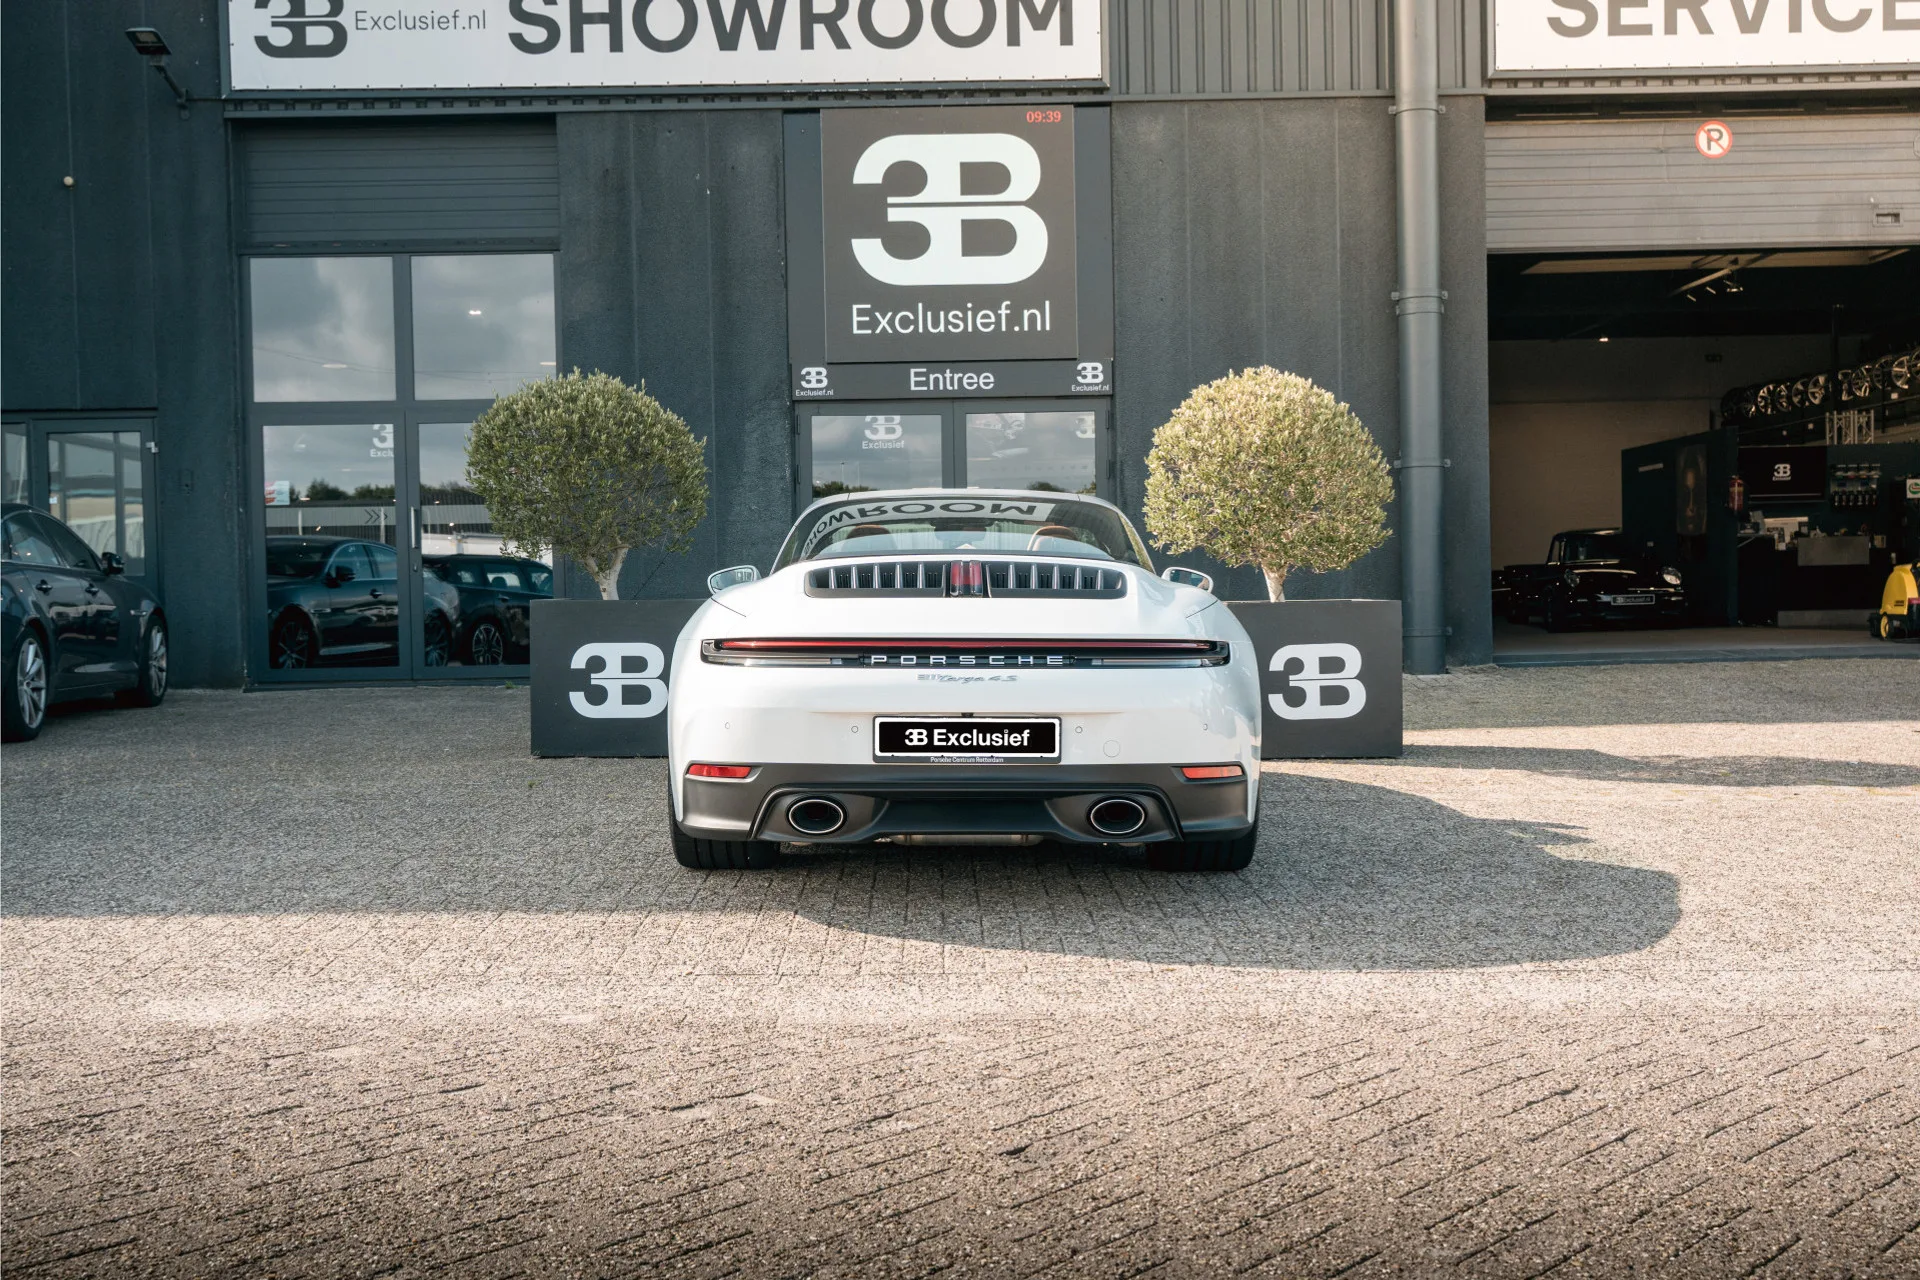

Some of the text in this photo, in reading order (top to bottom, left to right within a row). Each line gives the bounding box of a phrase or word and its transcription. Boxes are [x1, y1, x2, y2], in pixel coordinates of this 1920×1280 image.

[354, 10, 486, 31] Exclusief.nl
[508, 0, 1073, 54] SHOWROOM
[1026, 111, 1062, 123] 09:39
[851, 133, 1048, 285] 3B
[852, 300, 1050, 334] Exclusief.nl
[800, 367, 828, 388] 3B
[910, 368, 995, 391] Entree
[1076, 362, 1104, 384] 3B
[795, 389, 834, 397] Exclusief.nl
[1071, 384, 1110, 392] Exclusief.nl
[862, 440, 905, 449] Exclusief
[871, 656, 1063, 665] PORSCHE
[569, 642, 668, 719] 3B
[1268, 643, 1366, 720] 3B
[933, 728, 1030, 746] Exclusief
